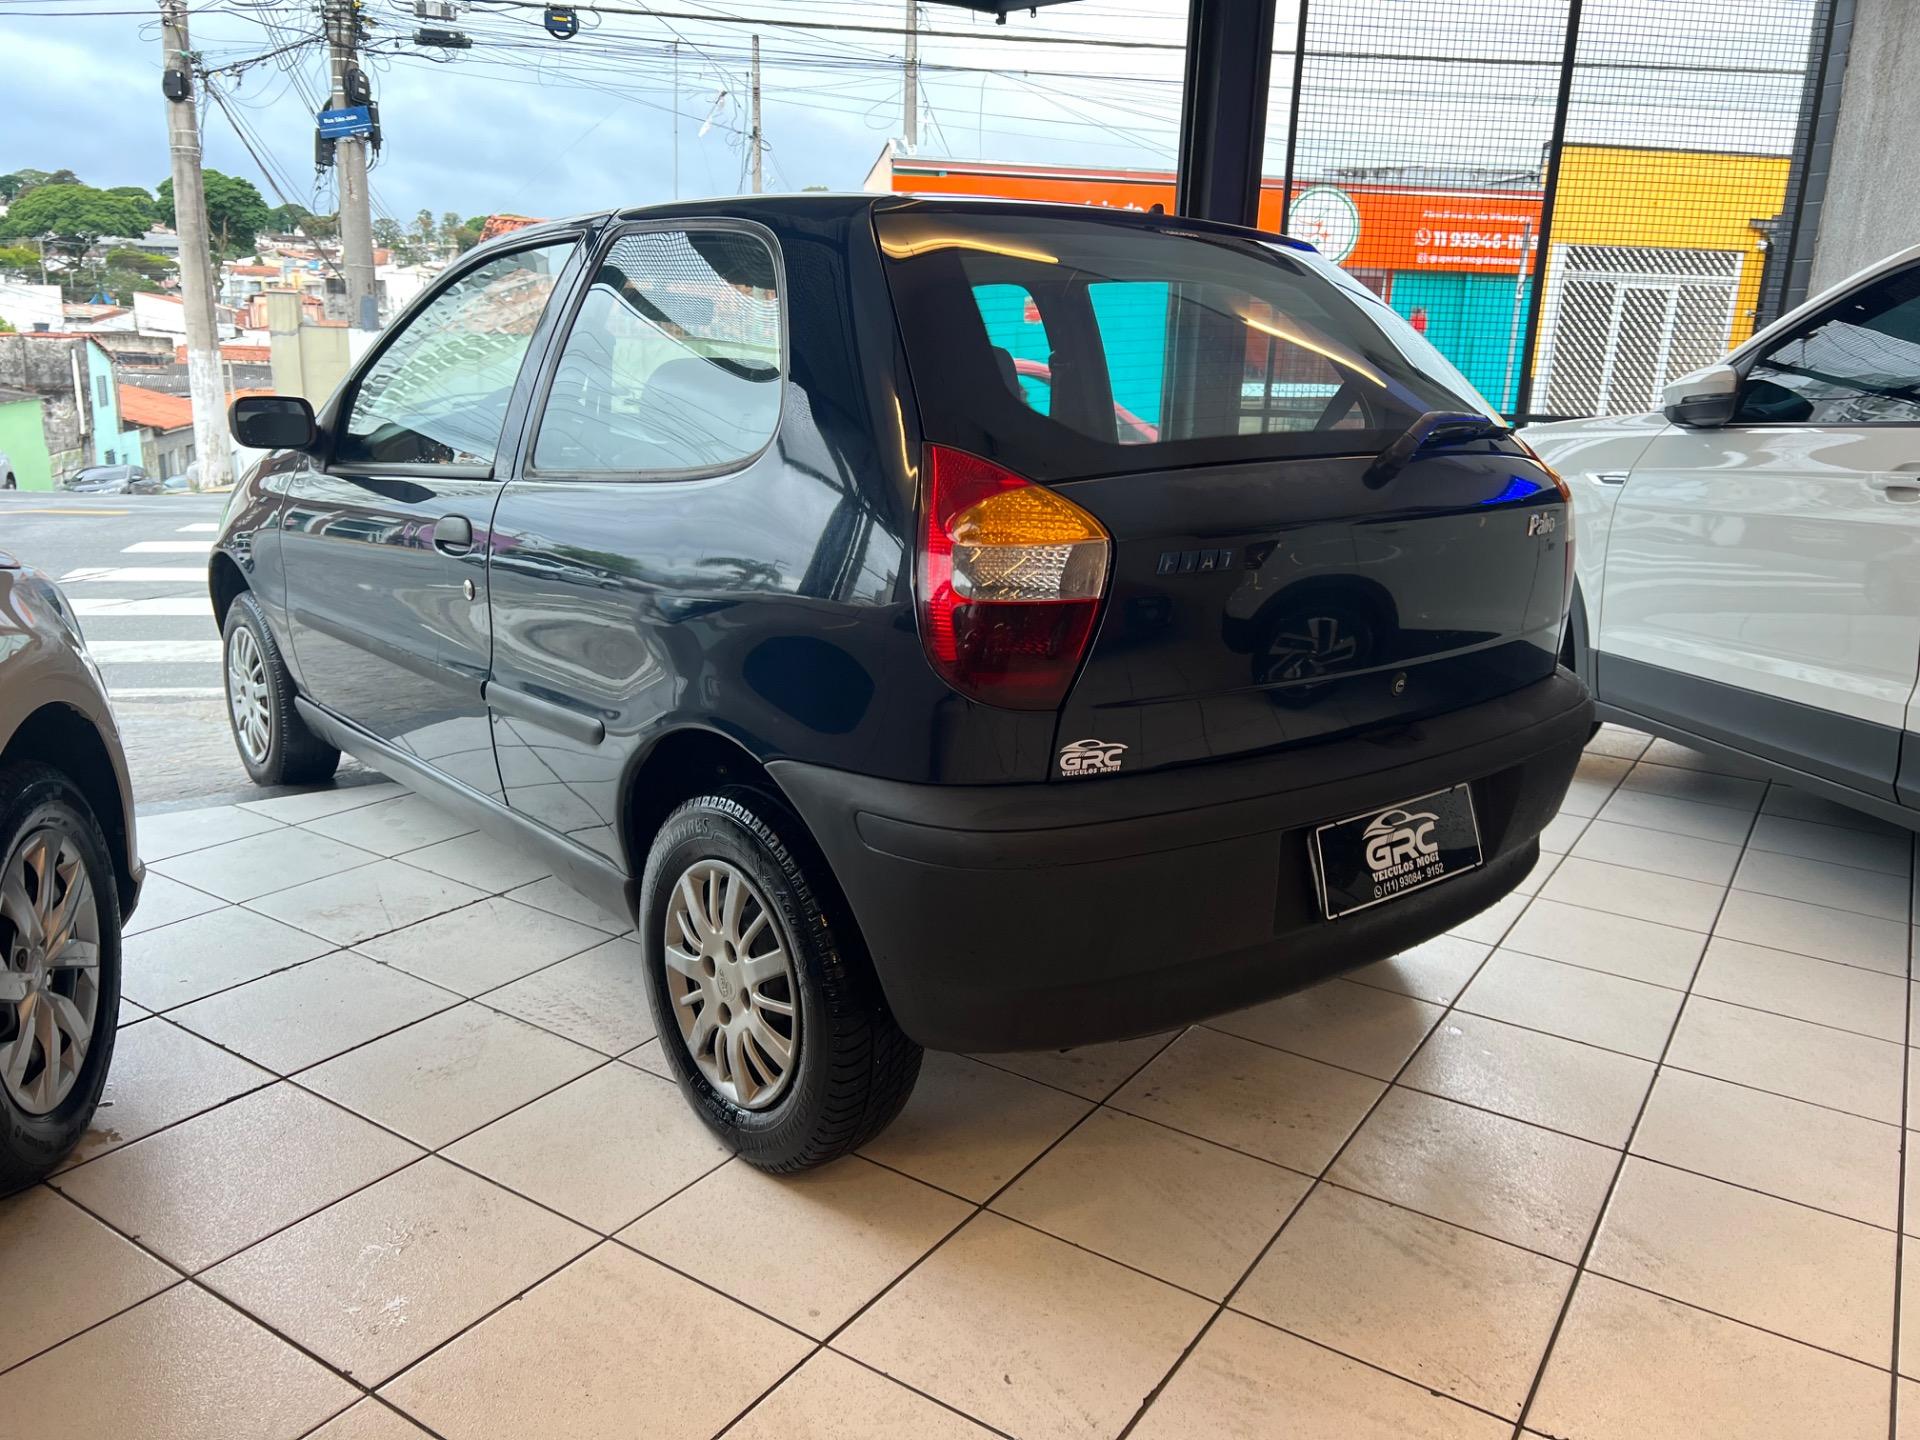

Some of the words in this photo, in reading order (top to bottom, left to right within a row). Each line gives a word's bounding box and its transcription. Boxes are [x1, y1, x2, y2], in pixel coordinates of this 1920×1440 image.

[1433, 231, 1447, 247] 11
[1528, 511, 1555, 537] Palio
[1160, 550, 1232, 574] FIAT
[1060, 748, 1122, 771] GRC
[1062, 768, 1097, 777] VEICULOS
[1100, 765, 1120, 773] MOGI
[1366, 821, 1439, 871] GRC
[1372, 860, 1414, 883] VEICULOS
[1416, 851, 1439, 868] MOGI
[1383, 879, 1399, 895] (11)
[1426, 862, 1445, 878] 9152
